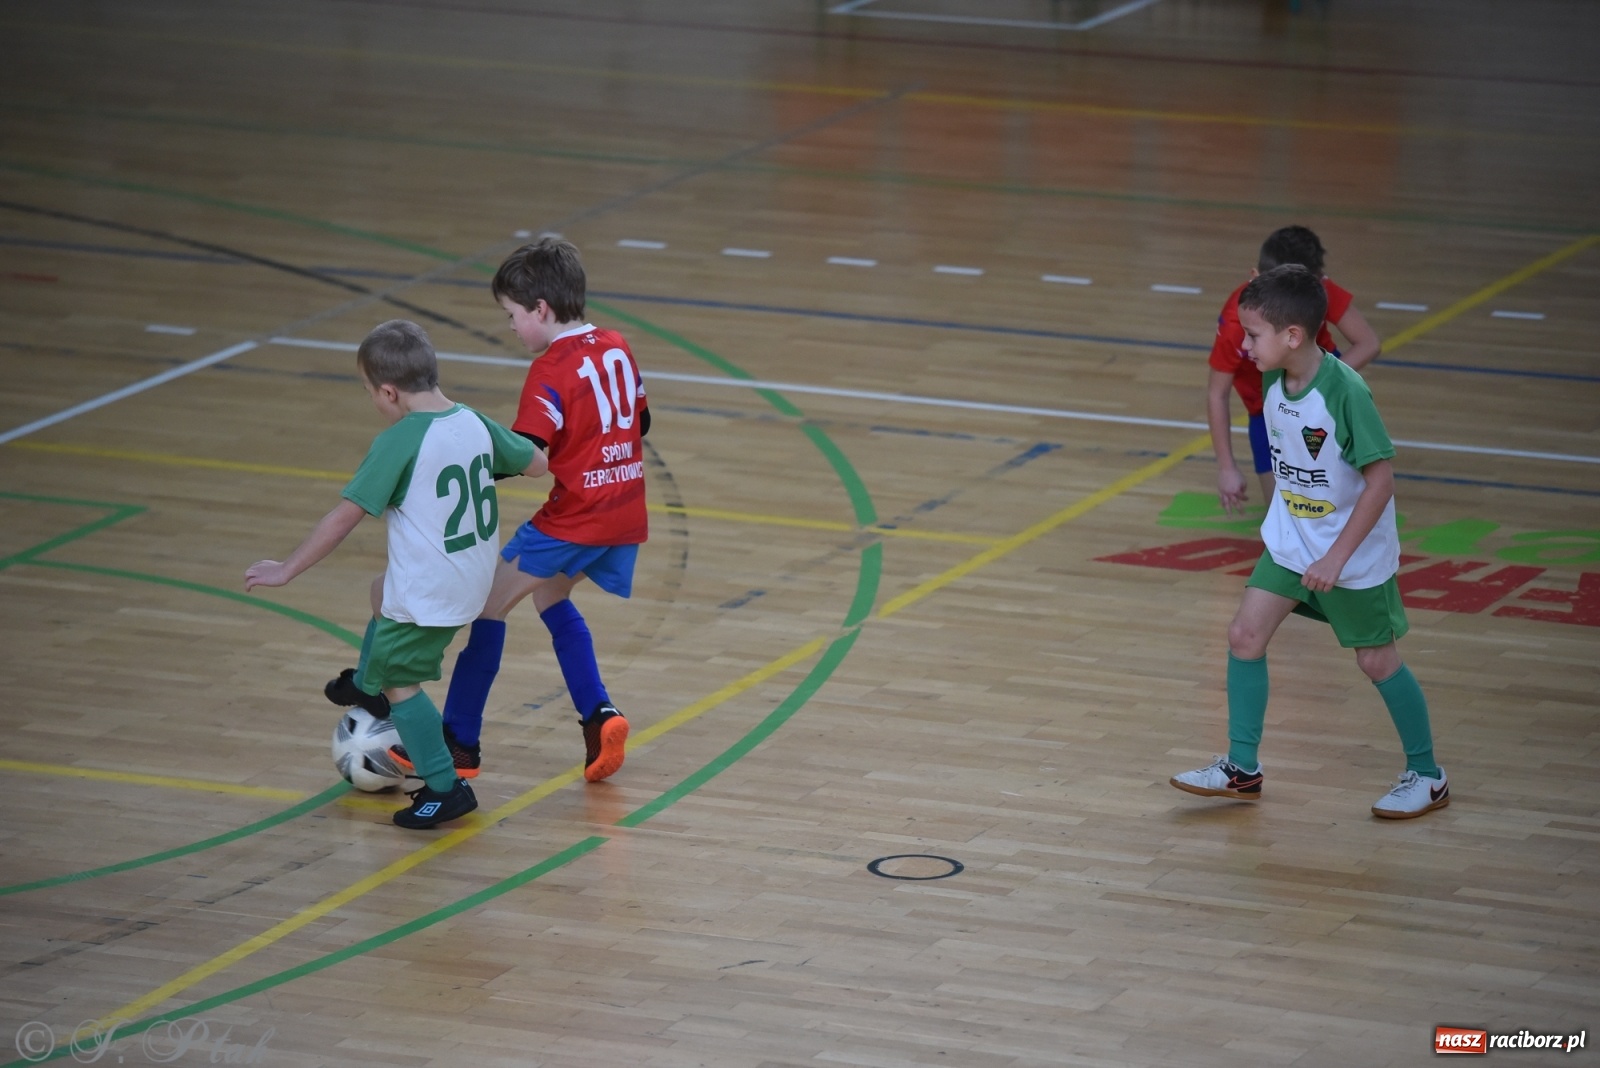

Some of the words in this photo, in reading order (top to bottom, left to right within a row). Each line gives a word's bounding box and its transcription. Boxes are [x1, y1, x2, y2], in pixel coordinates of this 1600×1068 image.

[576, 348, 637, 434] 10
[436, 453, 499, 554] 26
[582, 461, 643, 489] ZEBRZYDOWIC
